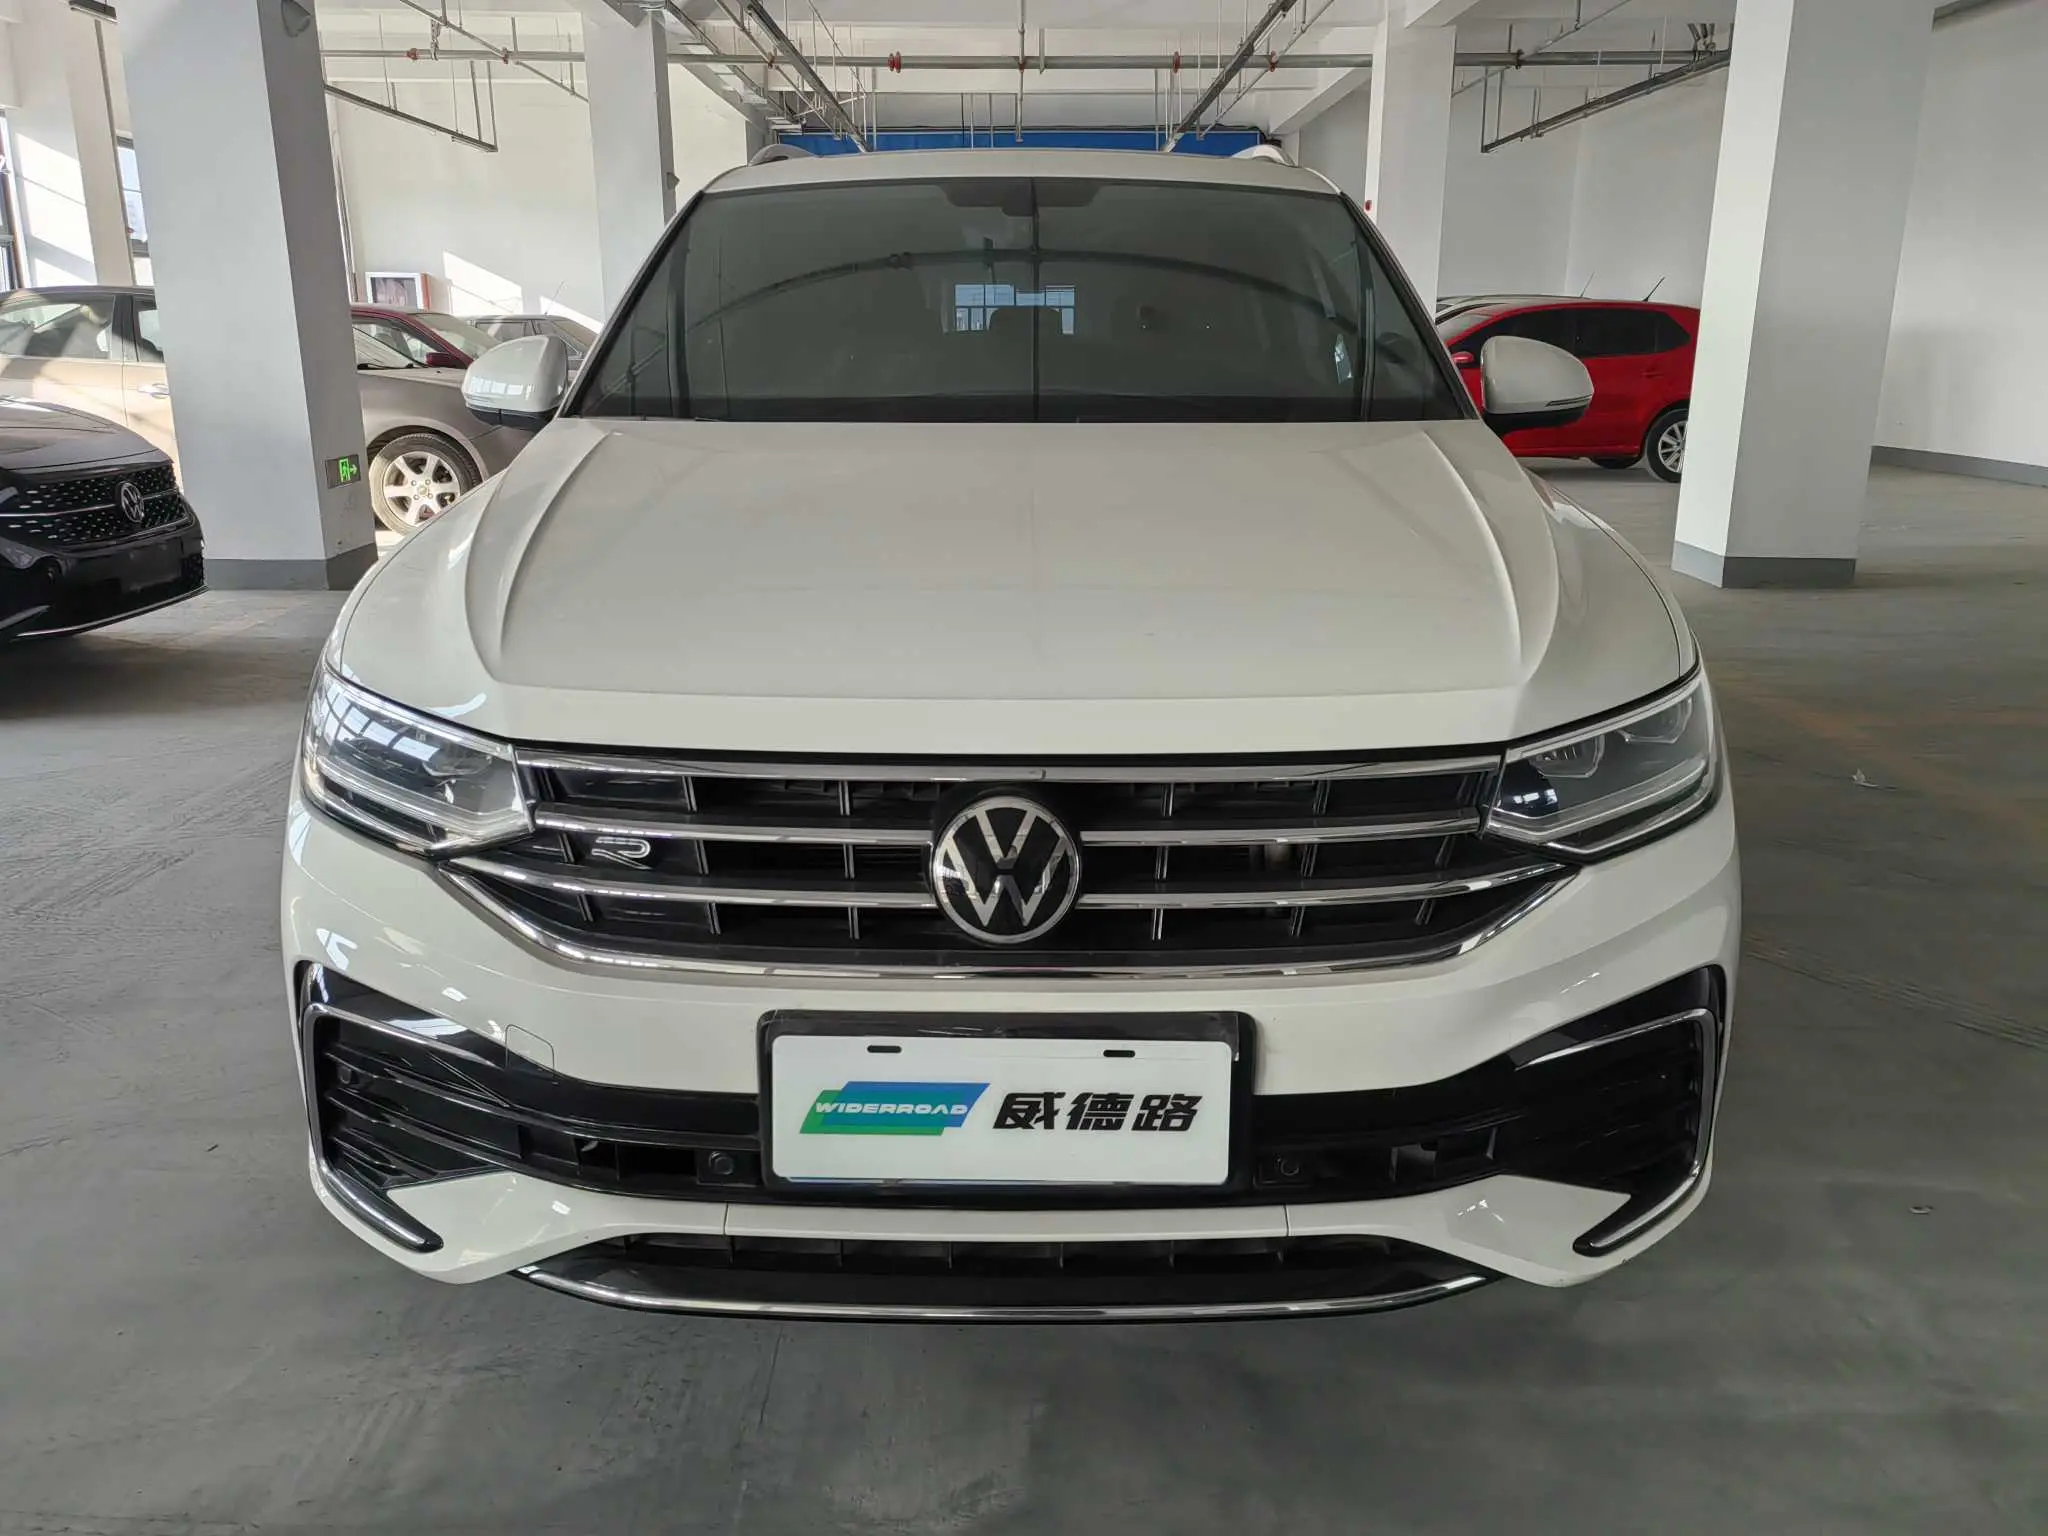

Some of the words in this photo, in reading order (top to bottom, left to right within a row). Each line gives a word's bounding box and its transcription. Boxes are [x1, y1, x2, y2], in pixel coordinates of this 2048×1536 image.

[935, 799, 1077, 940] VW
[815, 1102, 968, 1115] WIDERROAD
[992, 1092, 1203, 1131] 威德路
